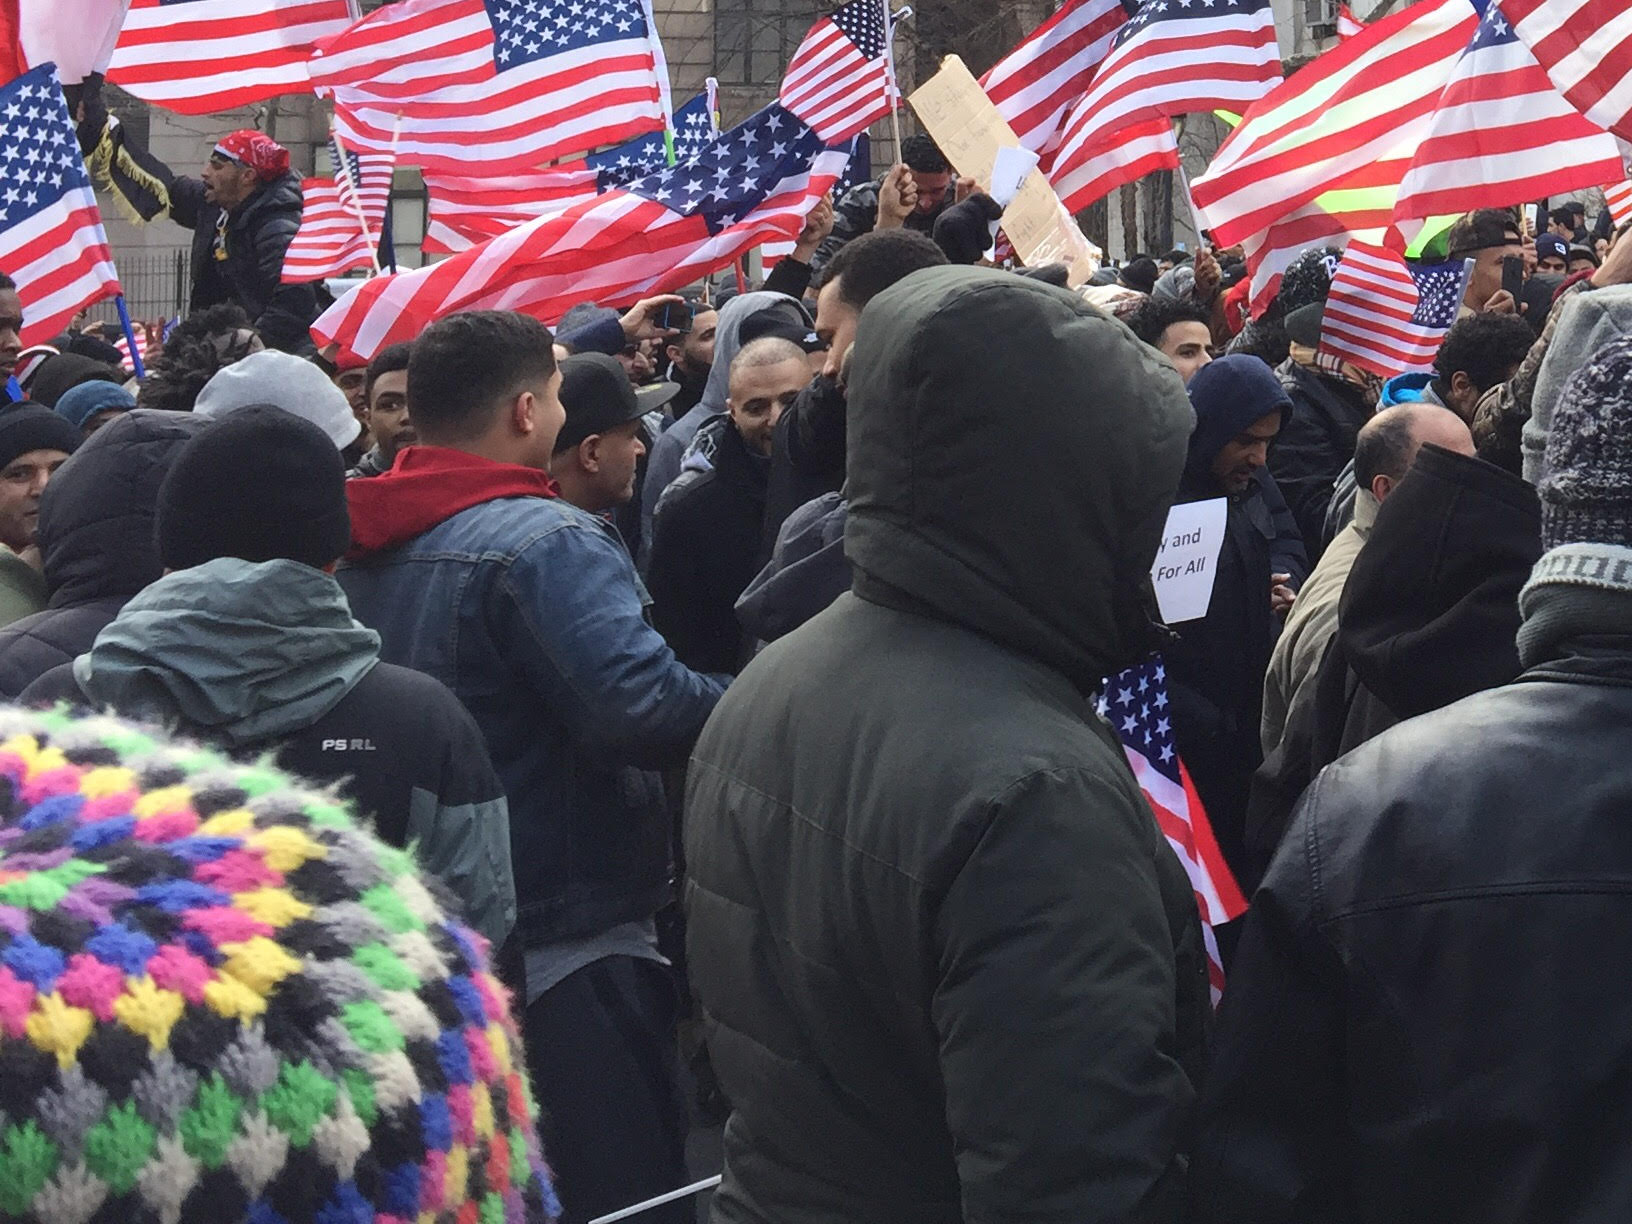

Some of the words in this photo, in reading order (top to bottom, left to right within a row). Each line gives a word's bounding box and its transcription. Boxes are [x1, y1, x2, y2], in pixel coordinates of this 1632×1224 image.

[1172, 527, 1201, 548] and
[1157, 565, 1182, 582] For
[1184, 556, 1206, 575] All
